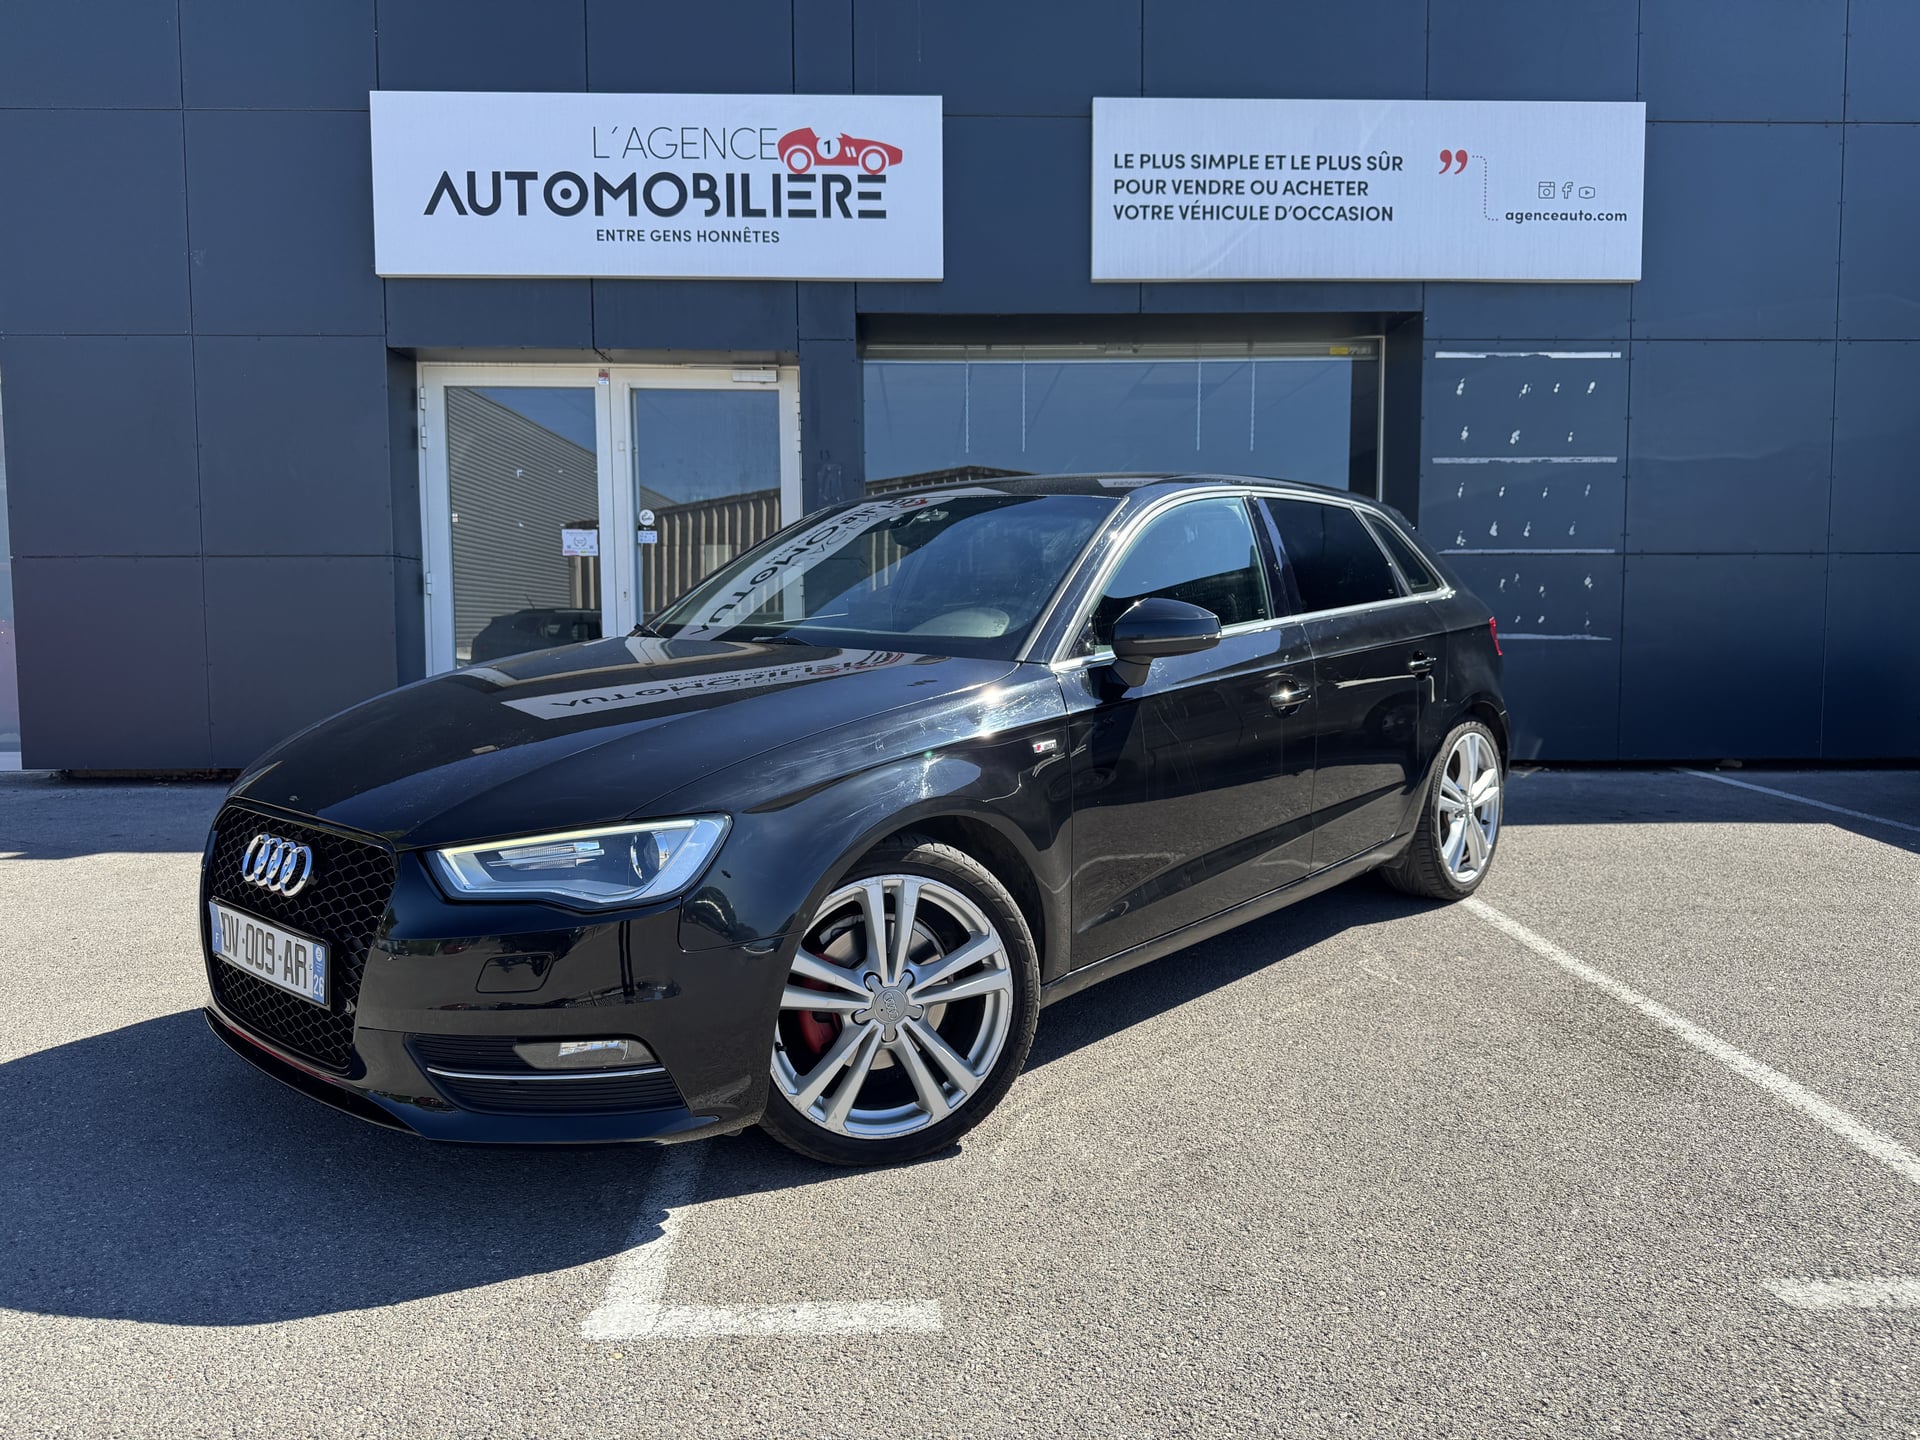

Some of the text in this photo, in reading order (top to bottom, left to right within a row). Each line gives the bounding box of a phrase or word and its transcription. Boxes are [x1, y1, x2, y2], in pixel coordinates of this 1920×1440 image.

[592, 126, 779, 160] L'AGENCE
[823, 139, 831, 155] 1
[1114, 150, 1404, 173] LE PLUS SIMPLE ET LE PLUS SÛR
[1114, 179, 1369, 197] POUR VENDRE OU ACHETER
[1113, 199, 1393, 222] VOTRE VÉHICULE D'OCCASION
[1505, 209, 1628, 224] agenceauto.com
[596, 226, 780, 244] ENTRE GENS HONNÊTES
[313, 974, 325, 998] 26
